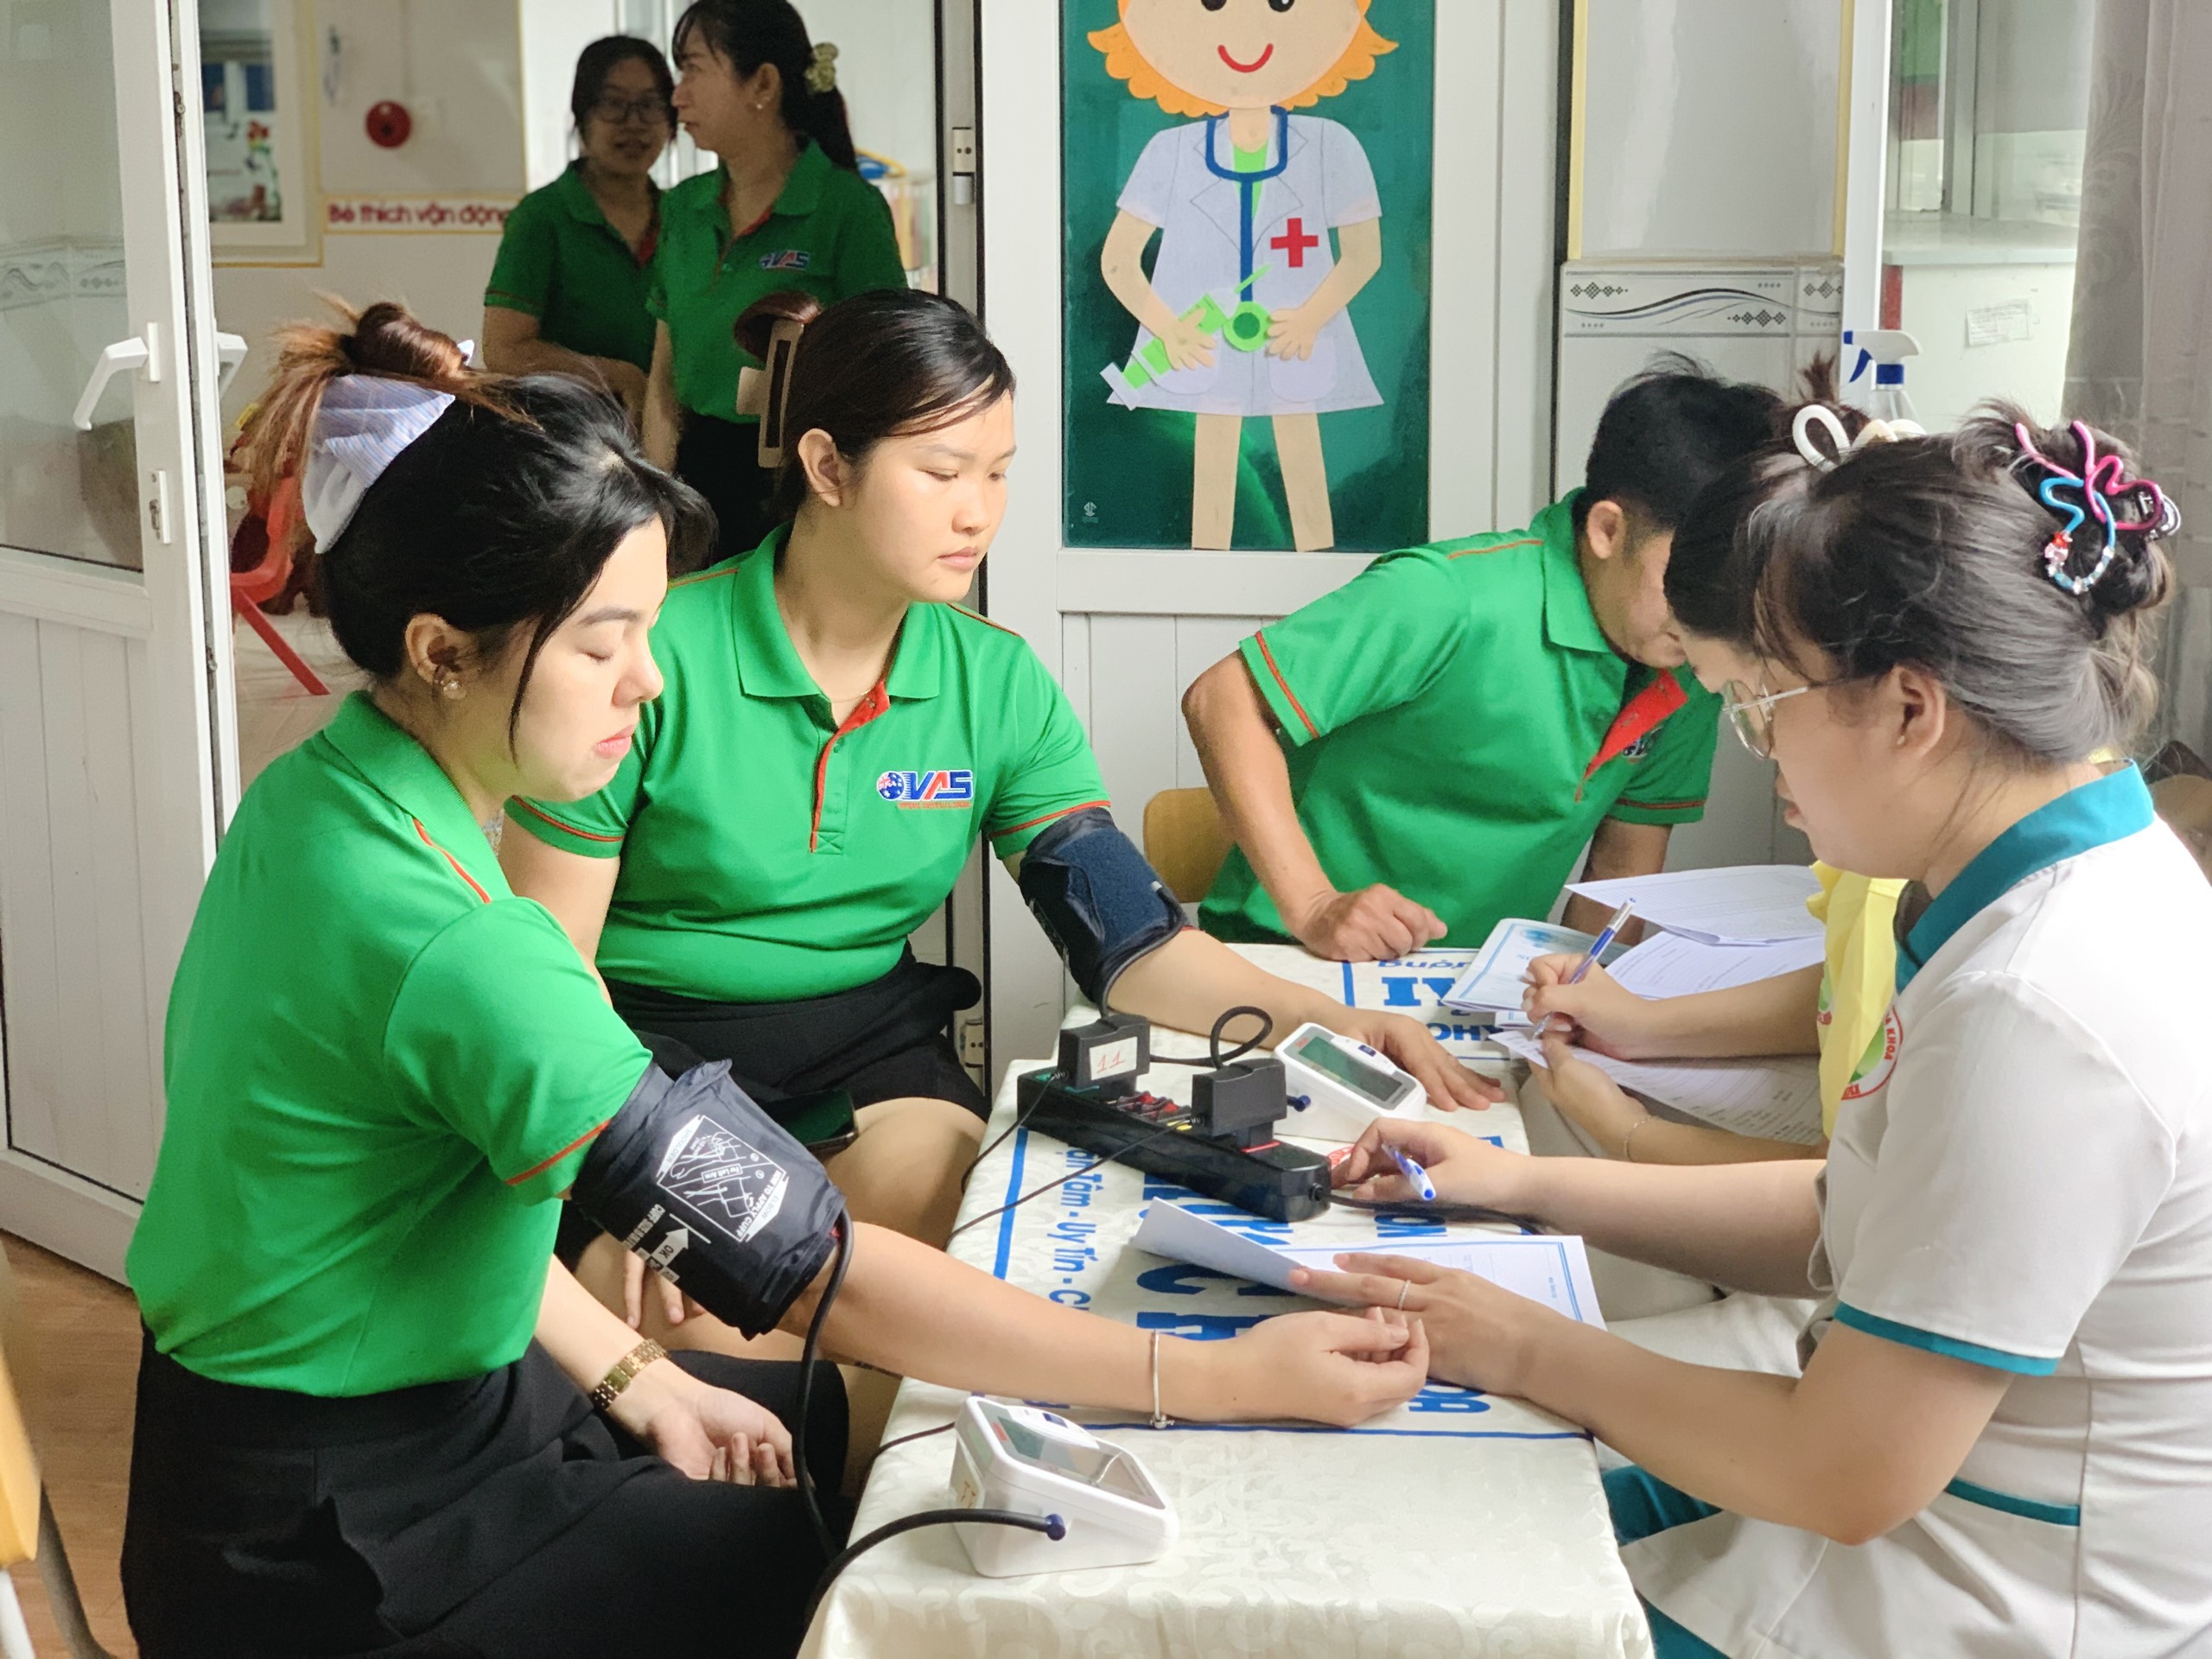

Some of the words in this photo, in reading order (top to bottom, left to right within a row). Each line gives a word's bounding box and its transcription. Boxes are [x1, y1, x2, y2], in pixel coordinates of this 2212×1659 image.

[900, 769, 973, 801] VAS
[769, 1169, 783, 1185] HOW
[763, 1184, 774, 1196] TO
[646, 1204, 665, 1224] CUFF
[748, 1193, 769, 1218] APPLY
[734, 1216, 753, 1237] CUFF
[1046, 1222, 1096, 1243] Uy
[658, 1244, 675, 1260] OK
[1053, 1248, 1098, 1272] Tín
